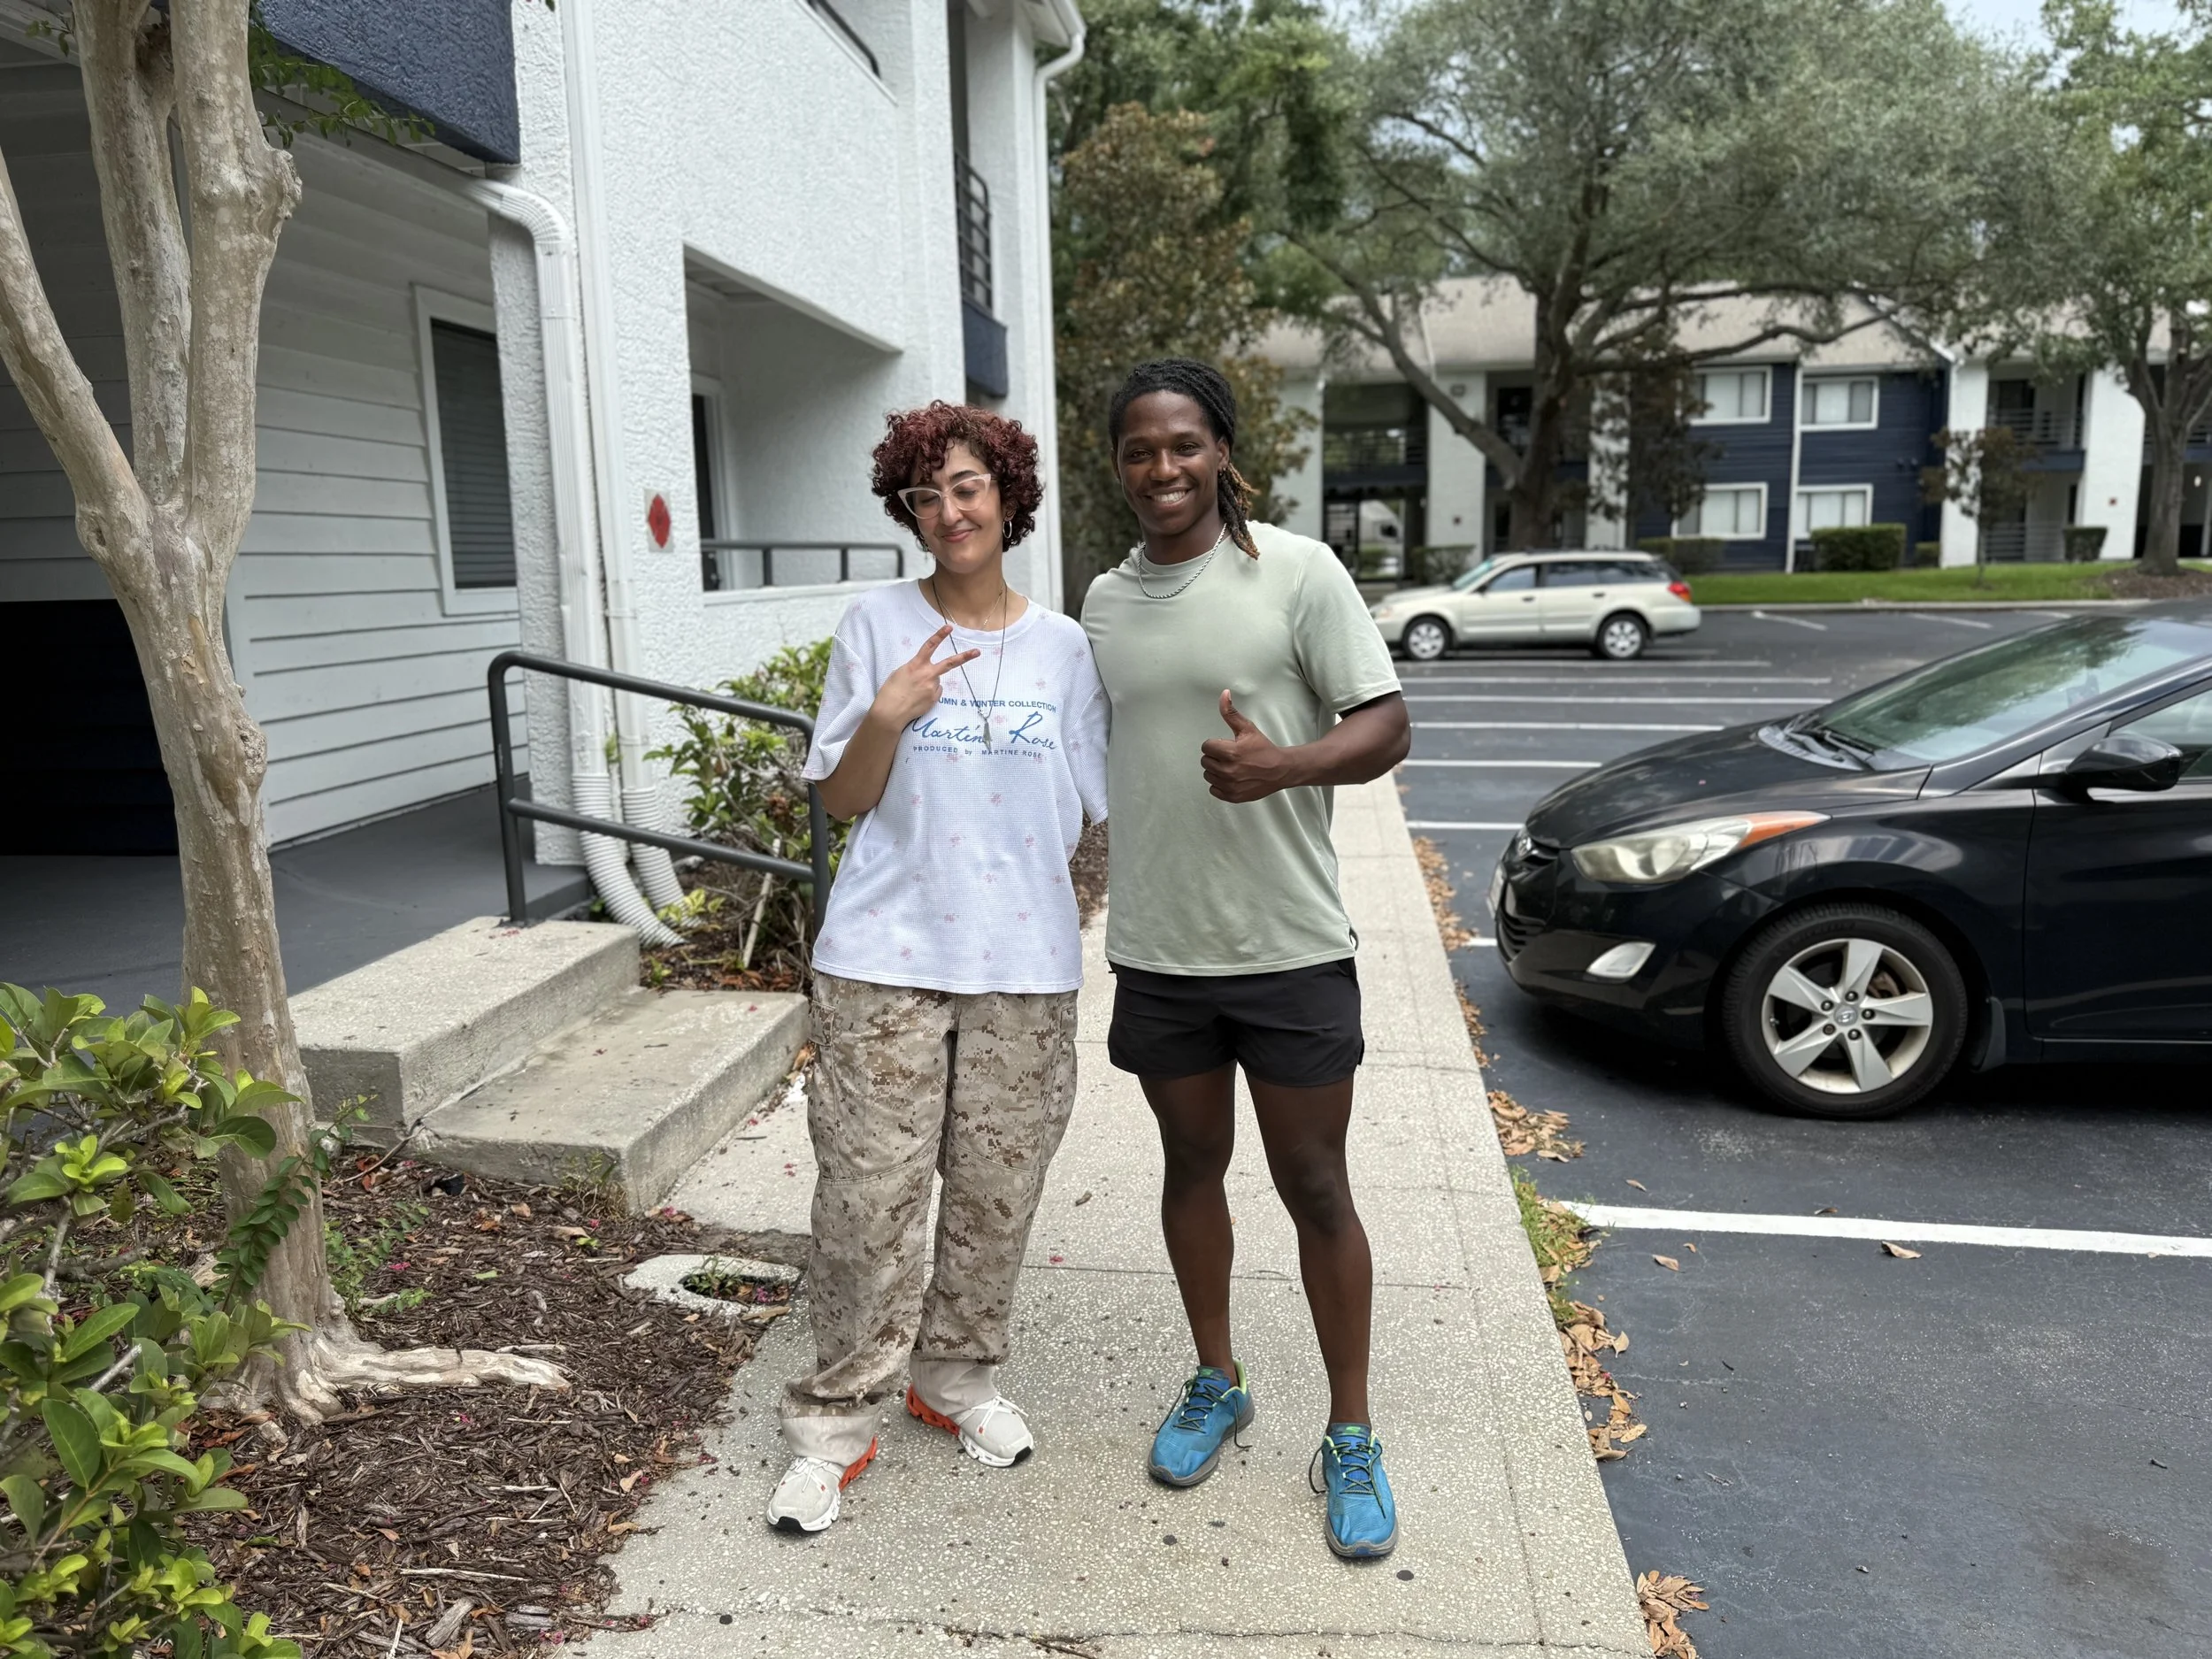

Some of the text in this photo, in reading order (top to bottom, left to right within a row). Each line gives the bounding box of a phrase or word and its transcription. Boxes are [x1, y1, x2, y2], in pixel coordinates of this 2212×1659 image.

[938, 697, 957, 706] UMN
[1009, 700, 1056, 713] COLLECTION
[912, 710, 1056, 749] Martin Rose
[1022, 749, 1041, 758] ROSE
